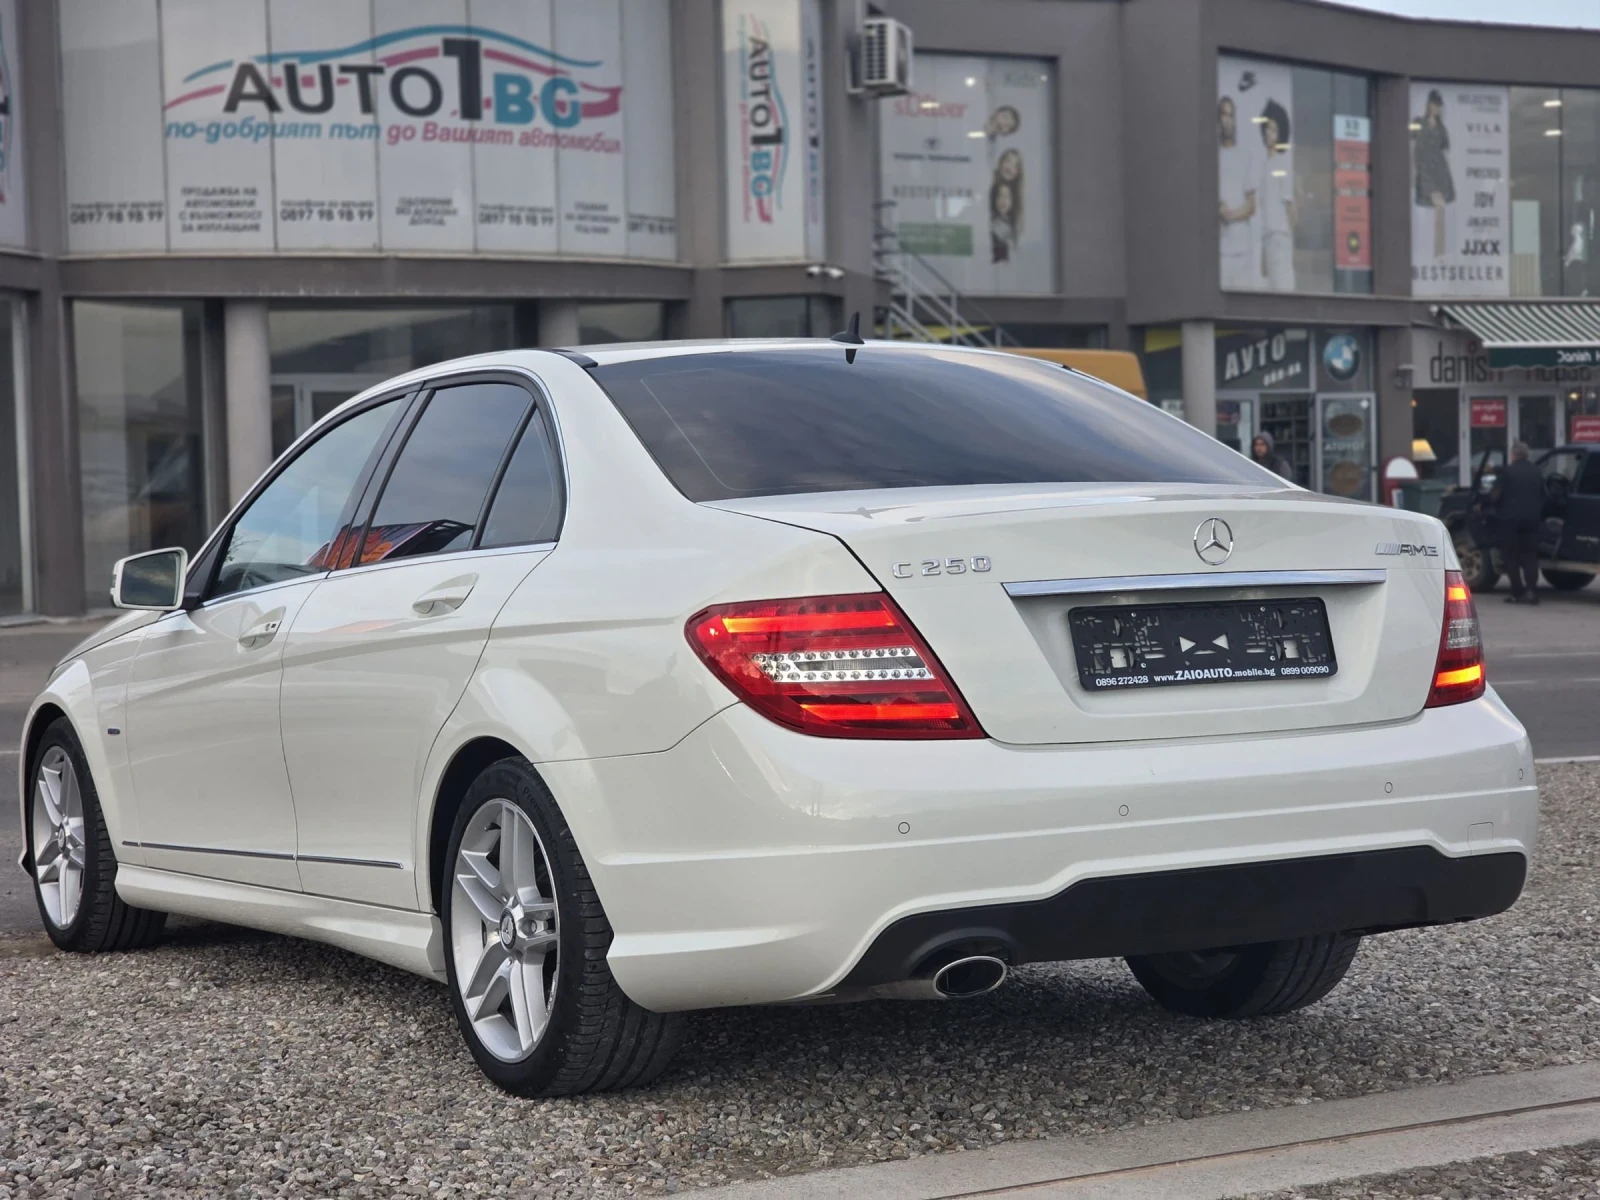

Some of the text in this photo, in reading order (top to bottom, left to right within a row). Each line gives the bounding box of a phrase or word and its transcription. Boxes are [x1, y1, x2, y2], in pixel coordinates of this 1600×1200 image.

[1461, 239, 1500, 256] JJXX
[1411, 265, 1503, 281] BESTSELLER
[1399, 543, 1439, 557] AMG
[892, 555, 992, 579] C 250
[1095, 665, 1330, 687] 0896 272428 www.ZAIOAUTO.mobile.bg 0899 009090
